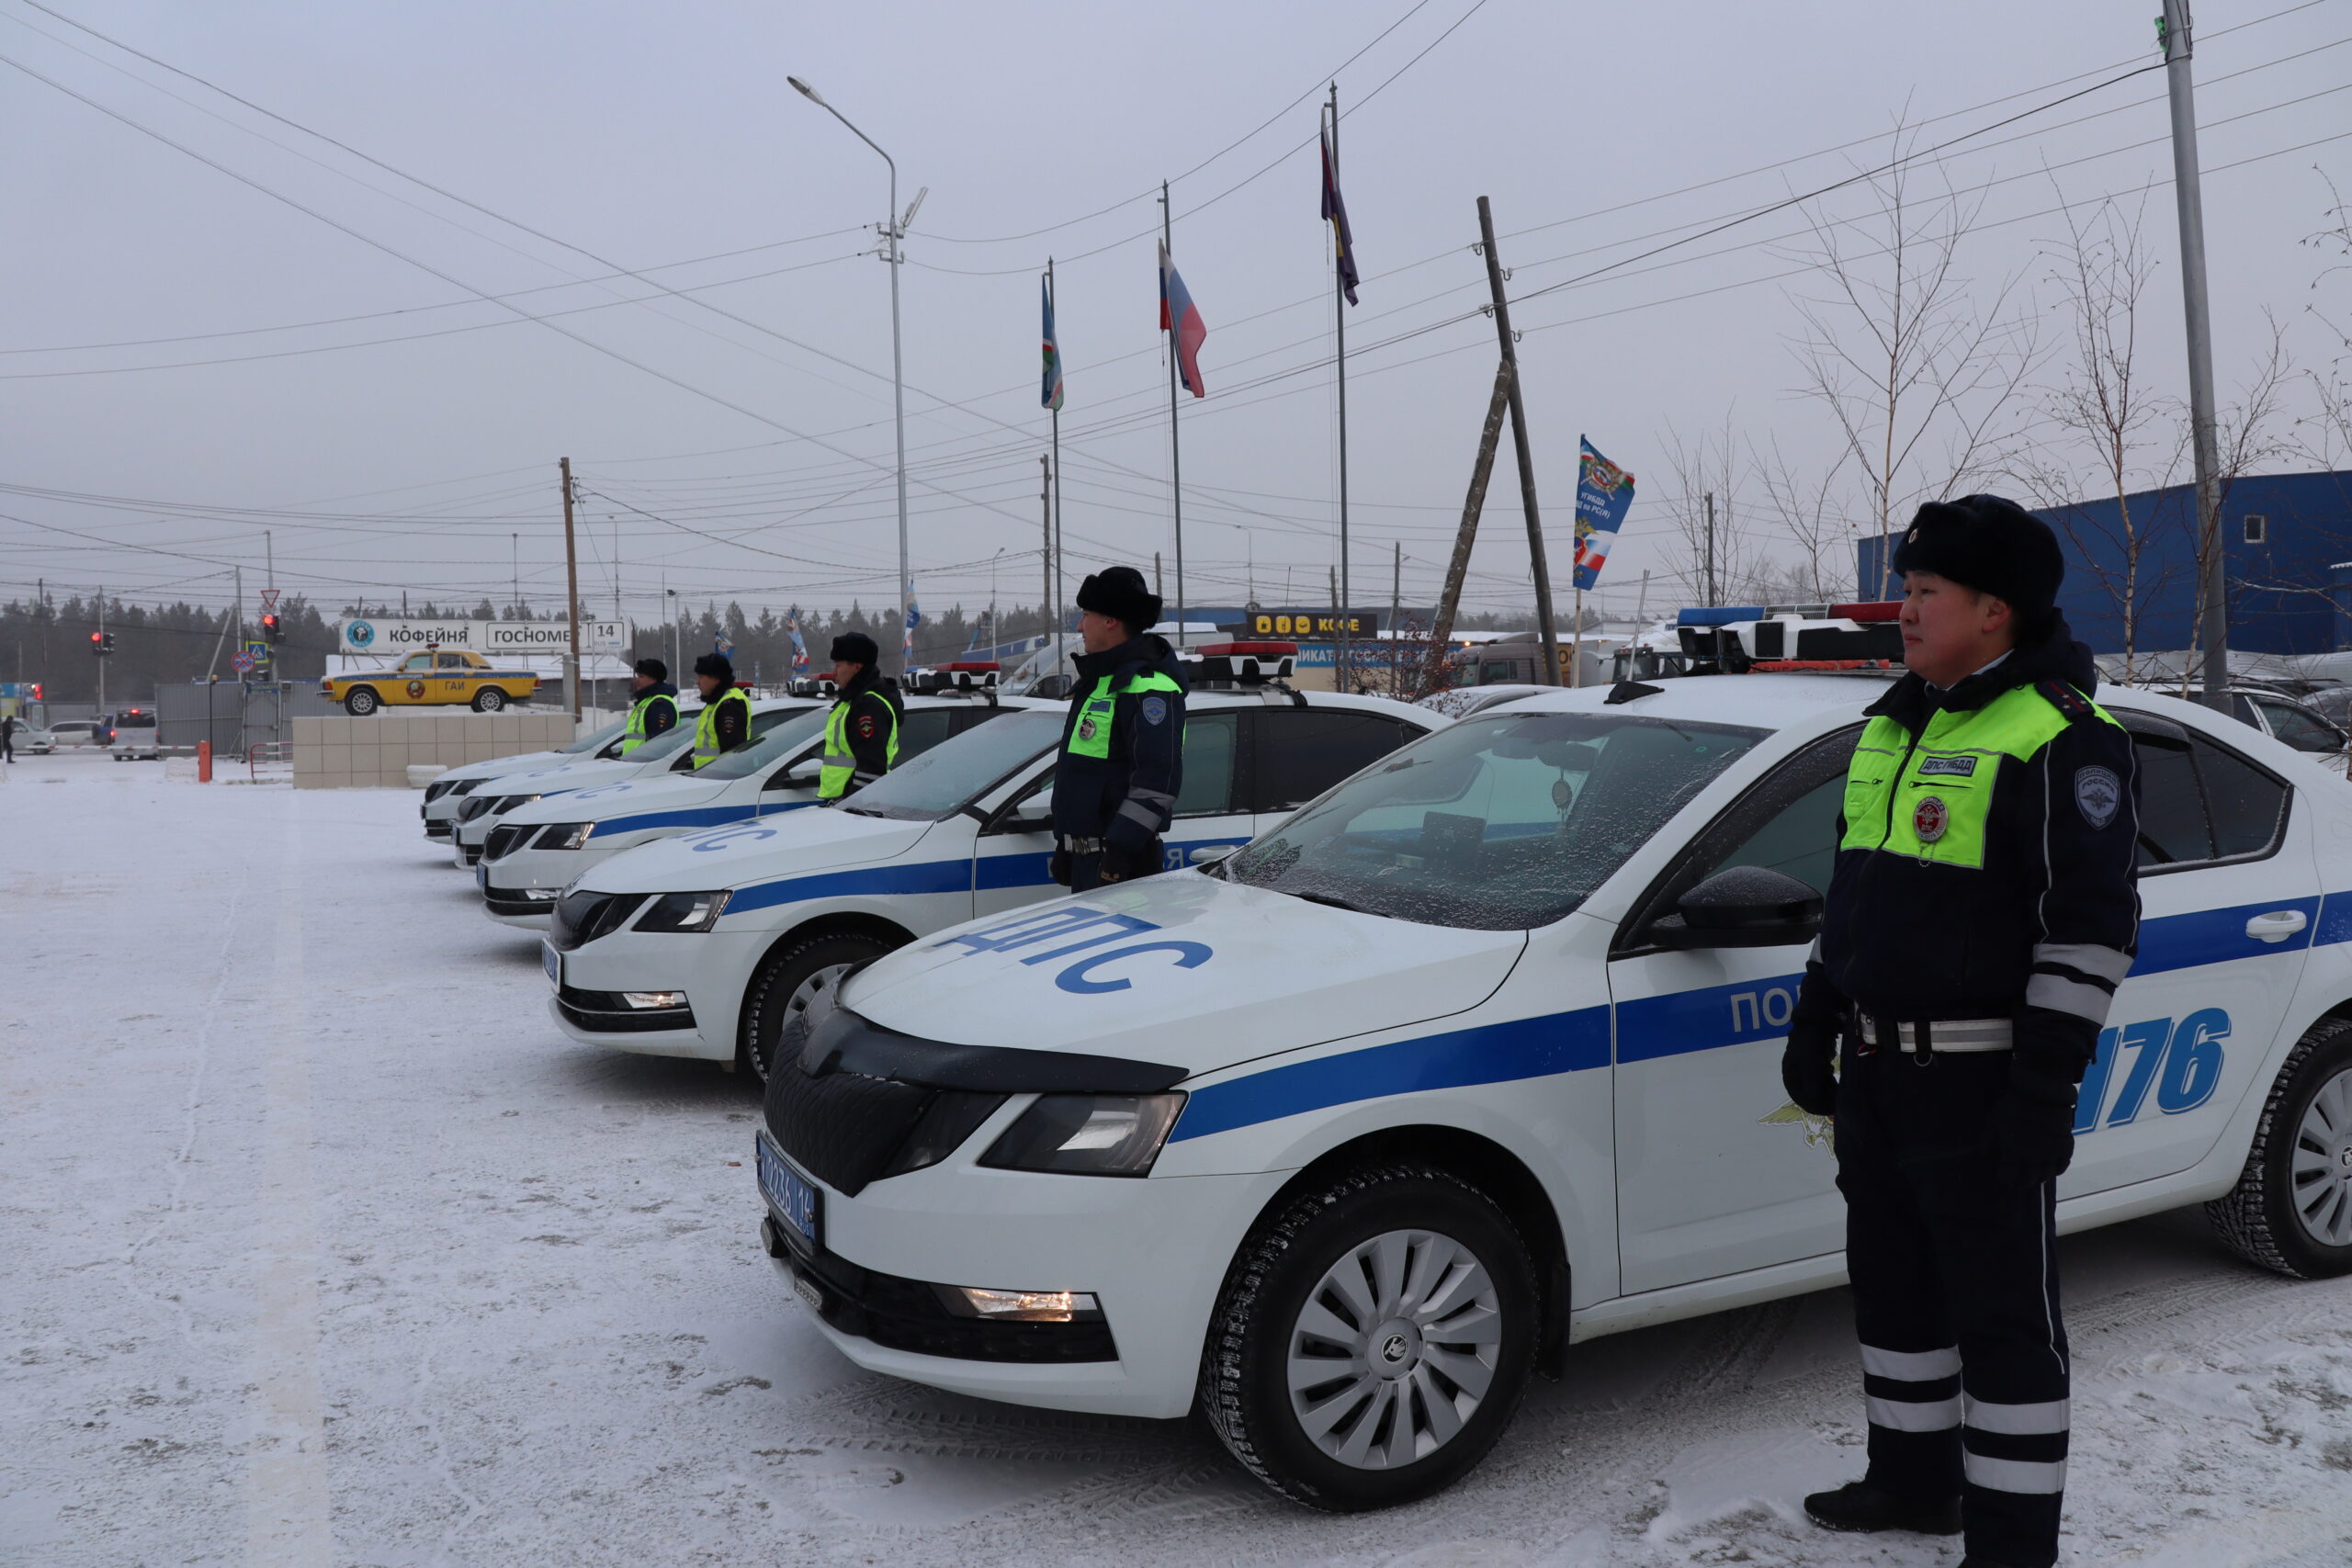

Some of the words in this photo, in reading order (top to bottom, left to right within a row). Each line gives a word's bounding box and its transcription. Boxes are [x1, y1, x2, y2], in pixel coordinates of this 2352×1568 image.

[390, 627, 469, 643] КОФЕЙНЯ
[494, 630, 580, 643] ГОСНОМЕ
[597, 625, 615, 637] 14
[446, 681, 465, 692] ГАИ
[1923, 761, 1944, 771] ДПС
[1941, 759, 1973, 772] ГИБДД
[2081, 778, 2115, 795] РОССИЯ
[936, 906, 1214, 995] ДПС
[1730, 984, 1802, 1033] ПО
[768, 1155, 792, 1214] 2236
